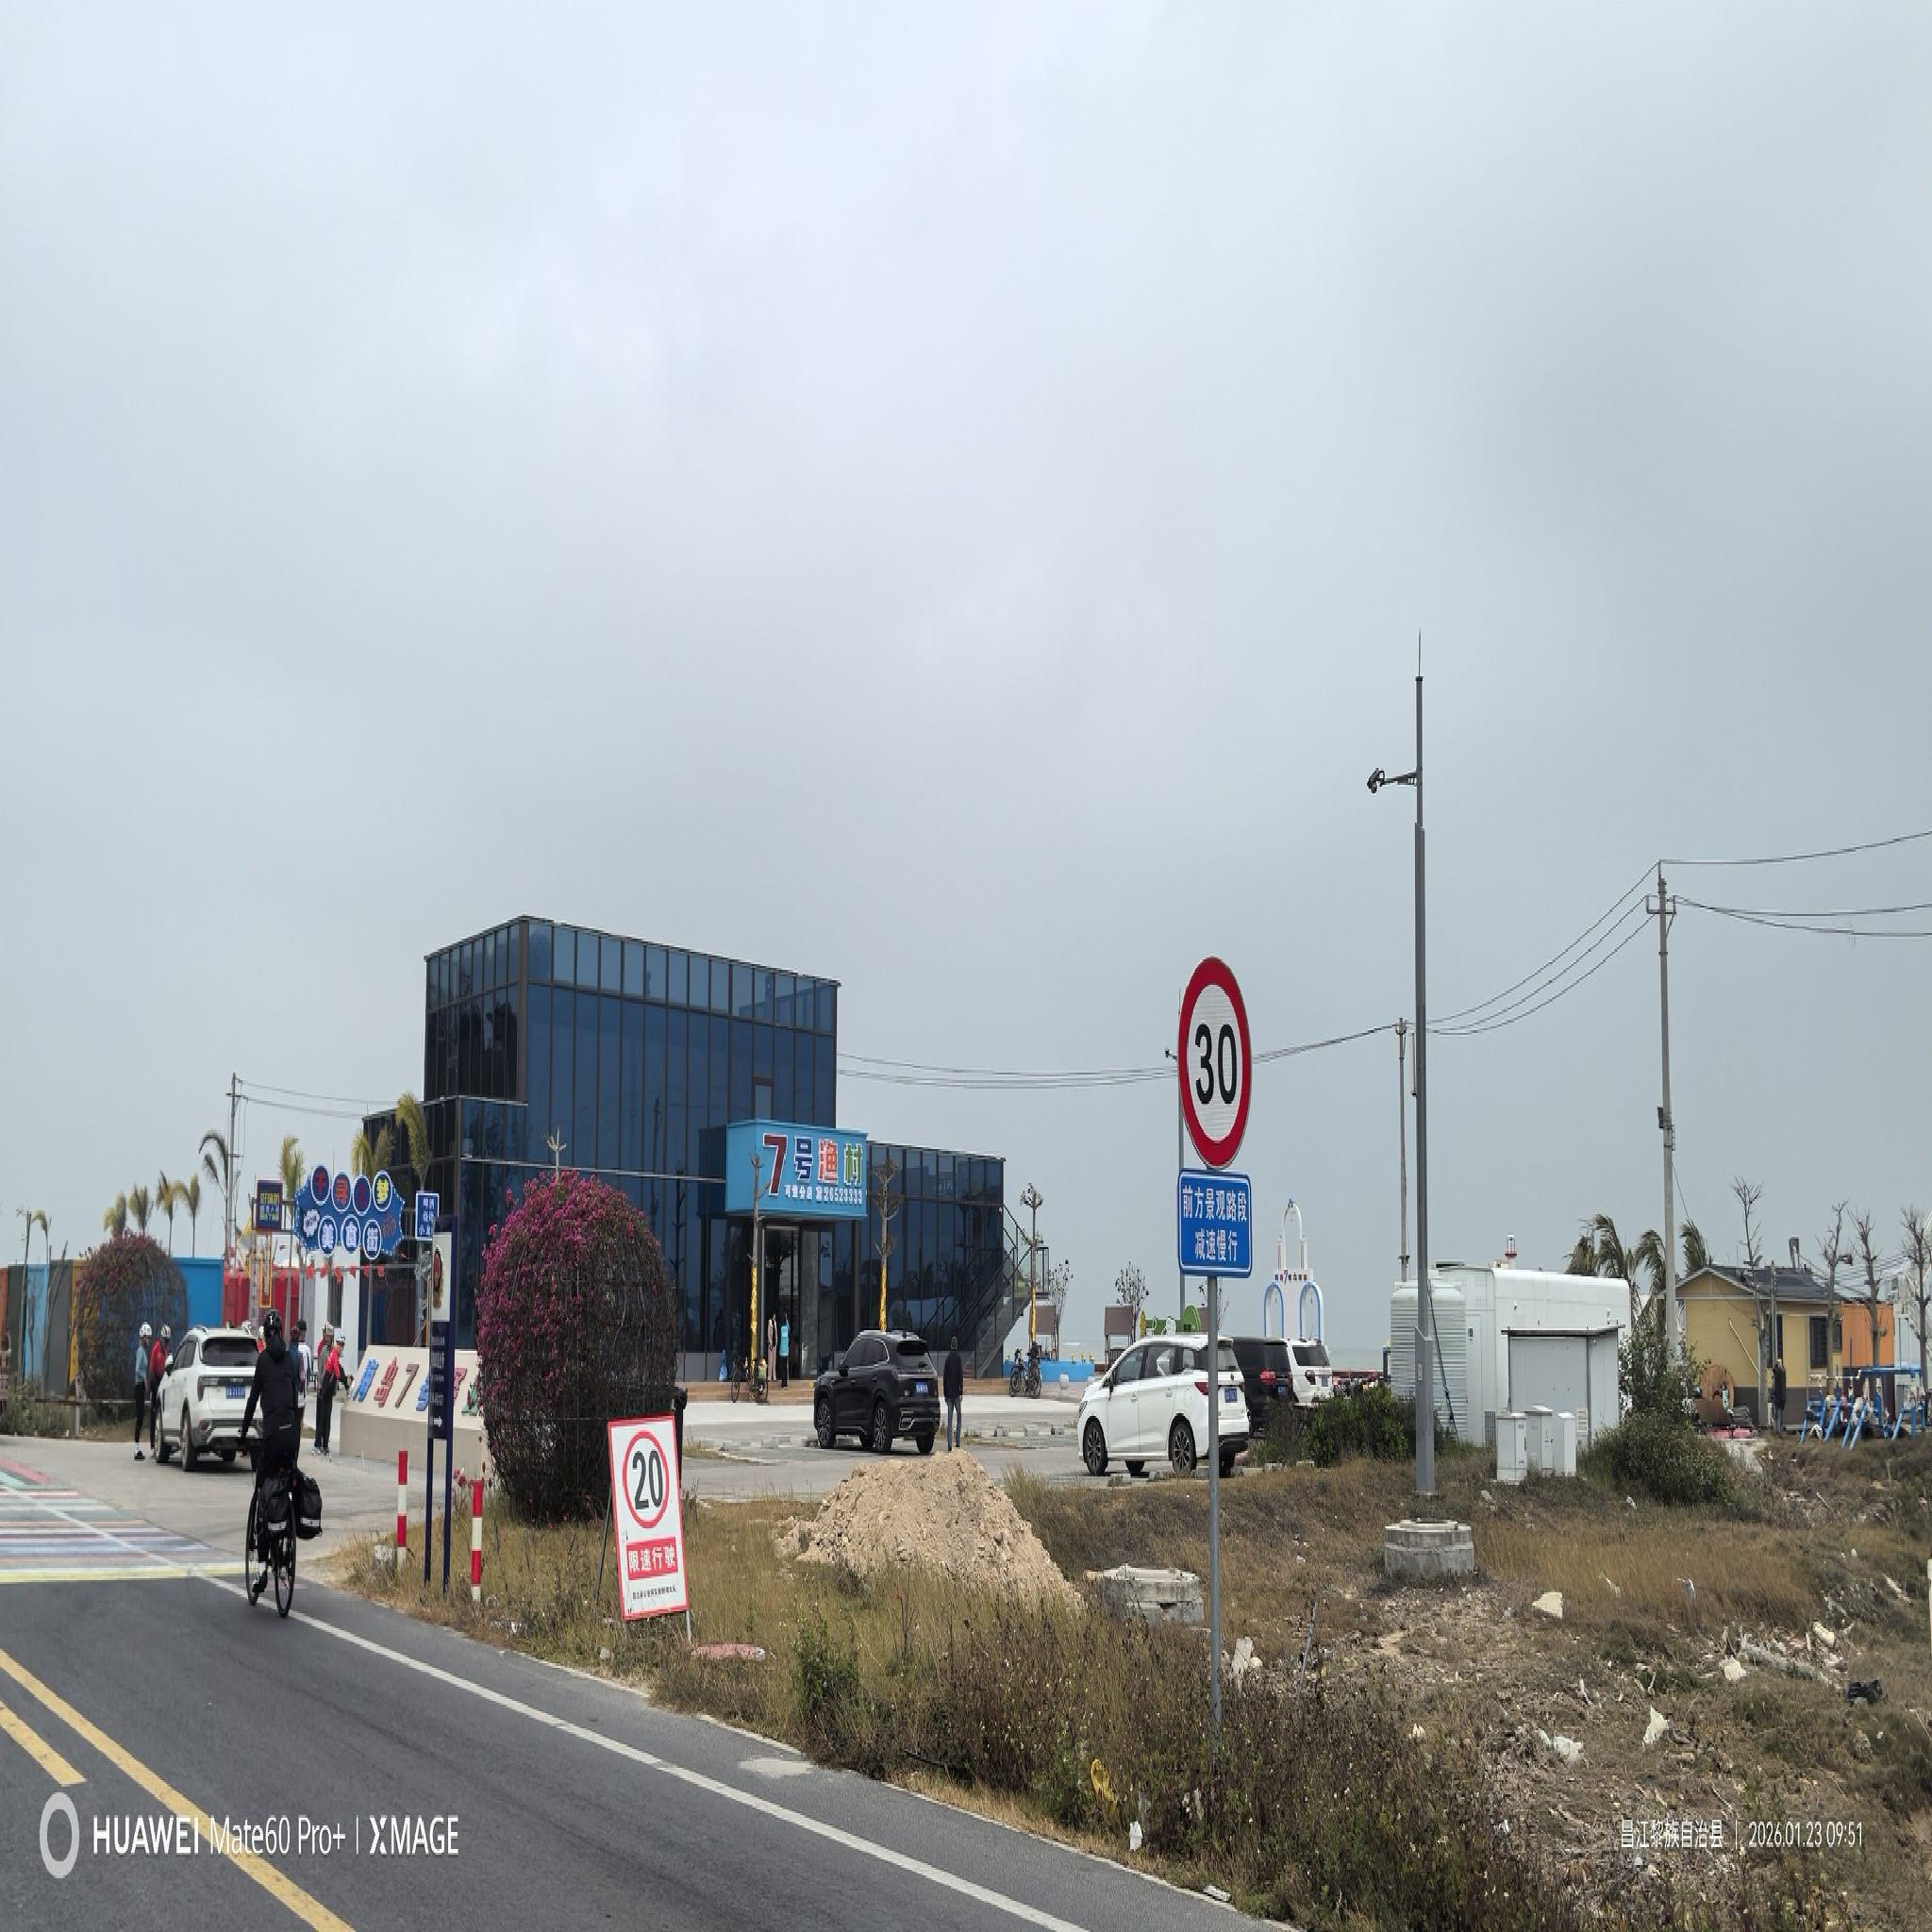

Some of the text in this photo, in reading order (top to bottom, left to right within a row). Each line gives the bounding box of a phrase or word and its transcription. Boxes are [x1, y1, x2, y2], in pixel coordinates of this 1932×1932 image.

[1194, 1023, 1238, 1105] 30
[762, 1133, 863, 1196] 7号渔村
[1182, 1185, 1247, 1223] 前方景观路段
[1194, 1227, 1239, 1262] 减速慢行
[632, 1449, 664, 1510] 20
[627, 1545, 676, 1573] 限速行驶
